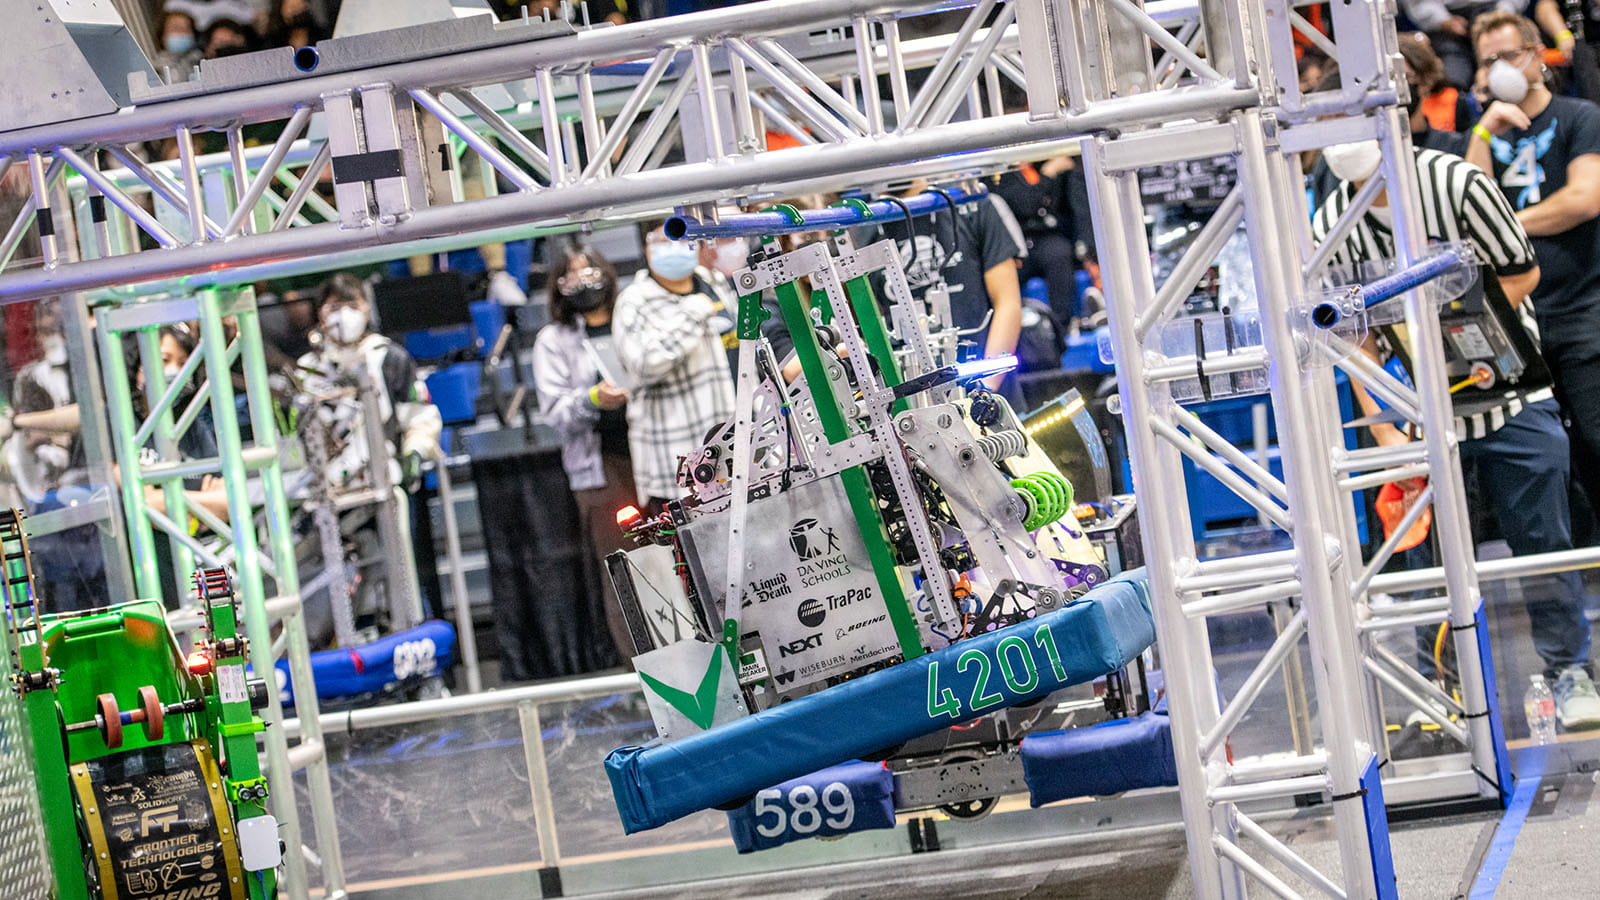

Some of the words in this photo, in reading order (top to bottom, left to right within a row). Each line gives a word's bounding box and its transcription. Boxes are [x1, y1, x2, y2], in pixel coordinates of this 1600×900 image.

[1501, 142, 1542, 204] 4
[797, 565, 815, 577] DA
[815, 554, 848, 570] VINCI
[801, 565, 851, 588] SCHOOLS
[749, 572, 787, 593] Liquid
[757, 584, 792, 604] Death
[826, 587, 872, 610] TraPac
[848, 614, 887, 632] BOEING
[778, 633, 823, 658] NEXT
[850, 644, 896, 664] Mendocino
[738, 666, 767, 679] BREAKER
[742, 663, 760, 672] MAIN
[799, 655, 846, 675] WISEBURN
[927, 624, 1068, 718] 4201
[138, 793, 188, 809] SOLIDWORKS
[755, 782, 855, 838] 589
[120, 841, 215, 869] TECHNOLOGIES
[133, 833, 198, 857] FRONTIER
